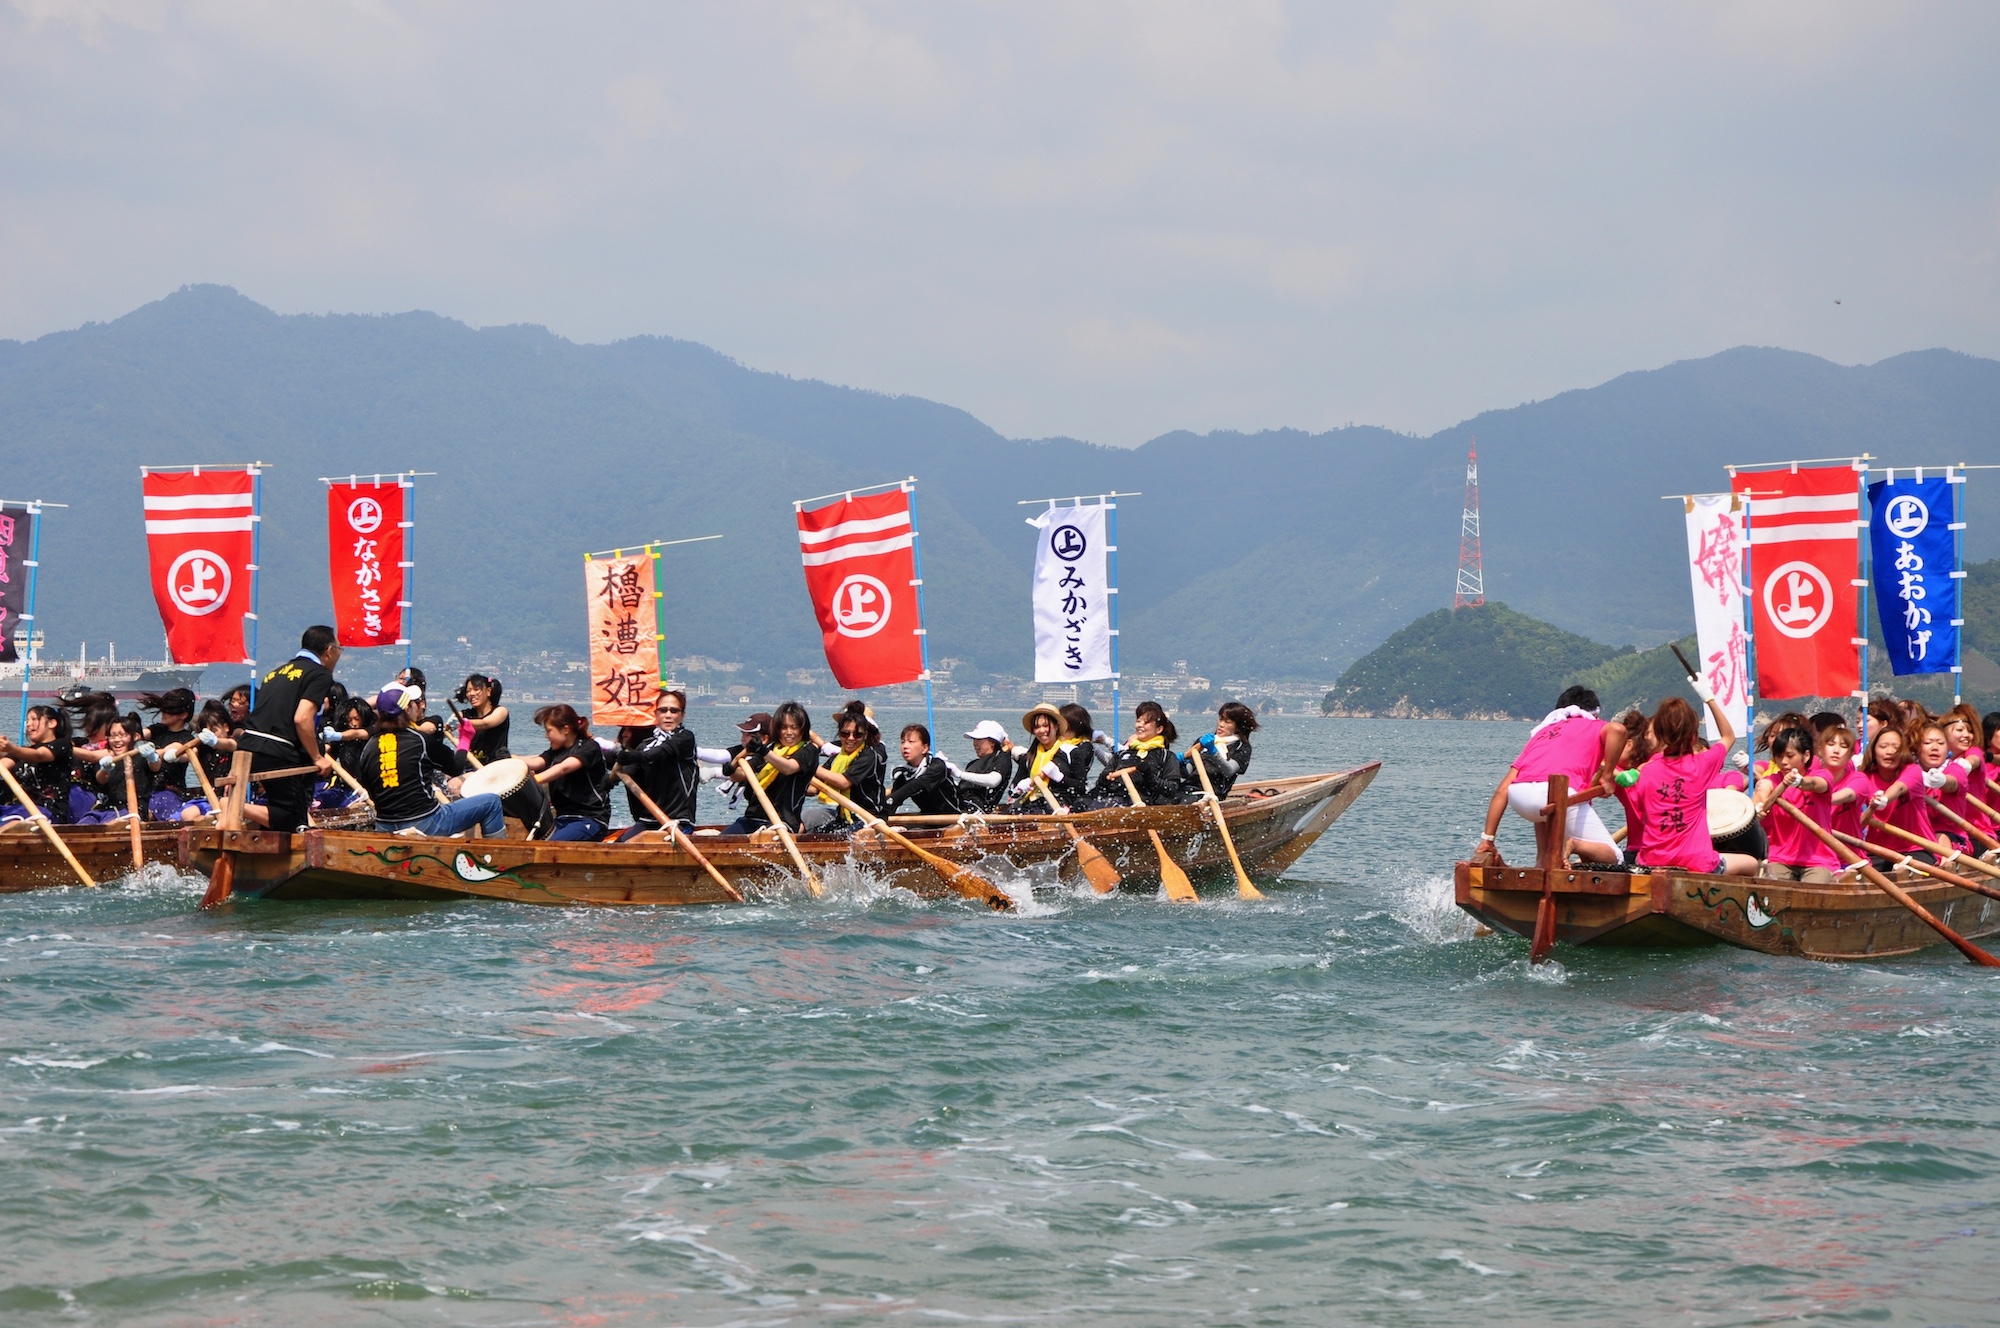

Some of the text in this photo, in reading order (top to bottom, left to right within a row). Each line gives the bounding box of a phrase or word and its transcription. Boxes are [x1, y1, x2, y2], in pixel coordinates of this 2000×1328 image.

[353, 536, 382, 637] ながさき
[596, 564, 654, 707] 櫓漕姫
[1059, 566, 1087, 670] みかざき
[1894, 540, 1933, 662] あおかげ
